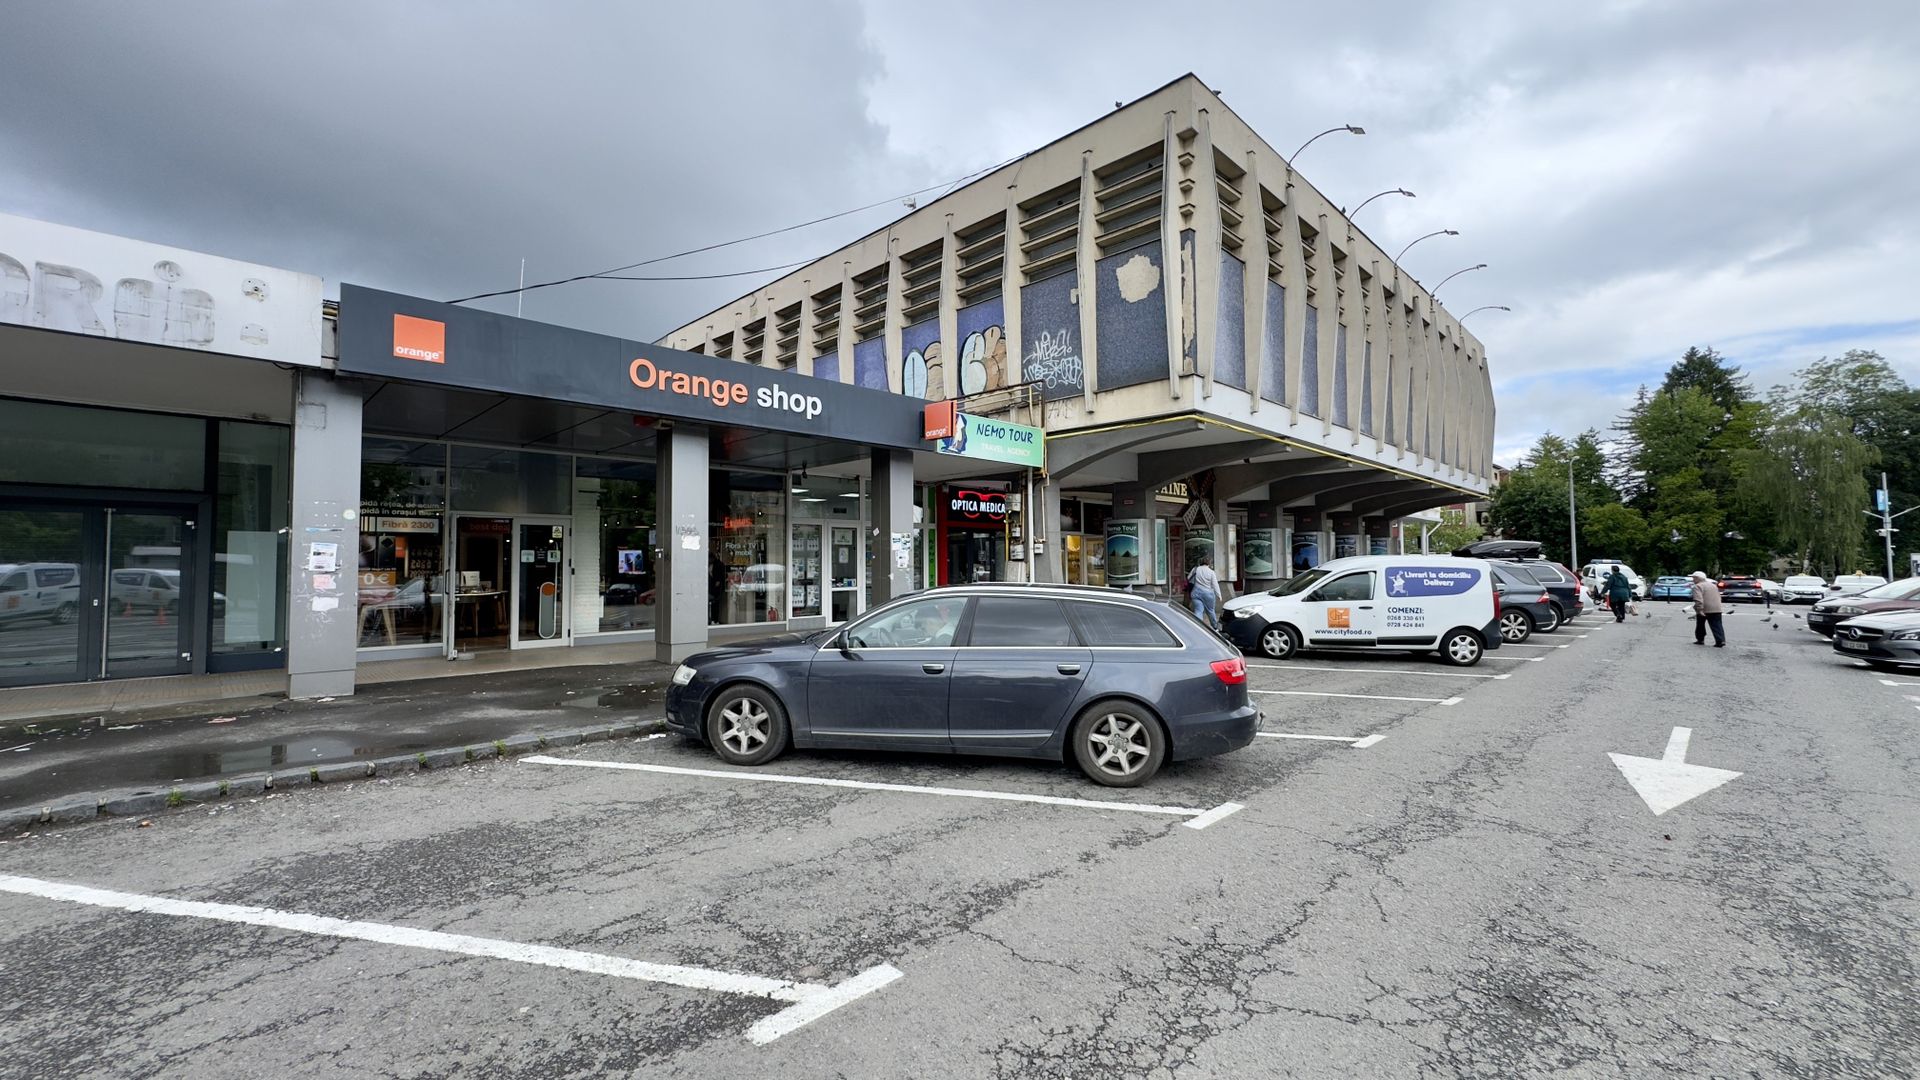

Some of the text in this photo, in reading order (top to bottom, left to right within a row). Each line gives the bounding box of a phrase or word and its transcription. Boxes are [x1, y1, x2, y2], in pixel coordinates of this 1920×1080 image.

[396, 346, 440, 361] orange
[628, 358, 823, 420] Orange shop
[926, 428, 946, 437] orange
[976, 423, 1034, 444] NEMO TOUR
[982, 442, 1031, 457] TRAVEL AGENCY
[1155, 482, 1188, 497] AINE
[951, 498, 1006, 514] OPTICA MEDICA
[411, 521, 434, 529] 2300
[1423, 579, 1455, 587] Delivery
